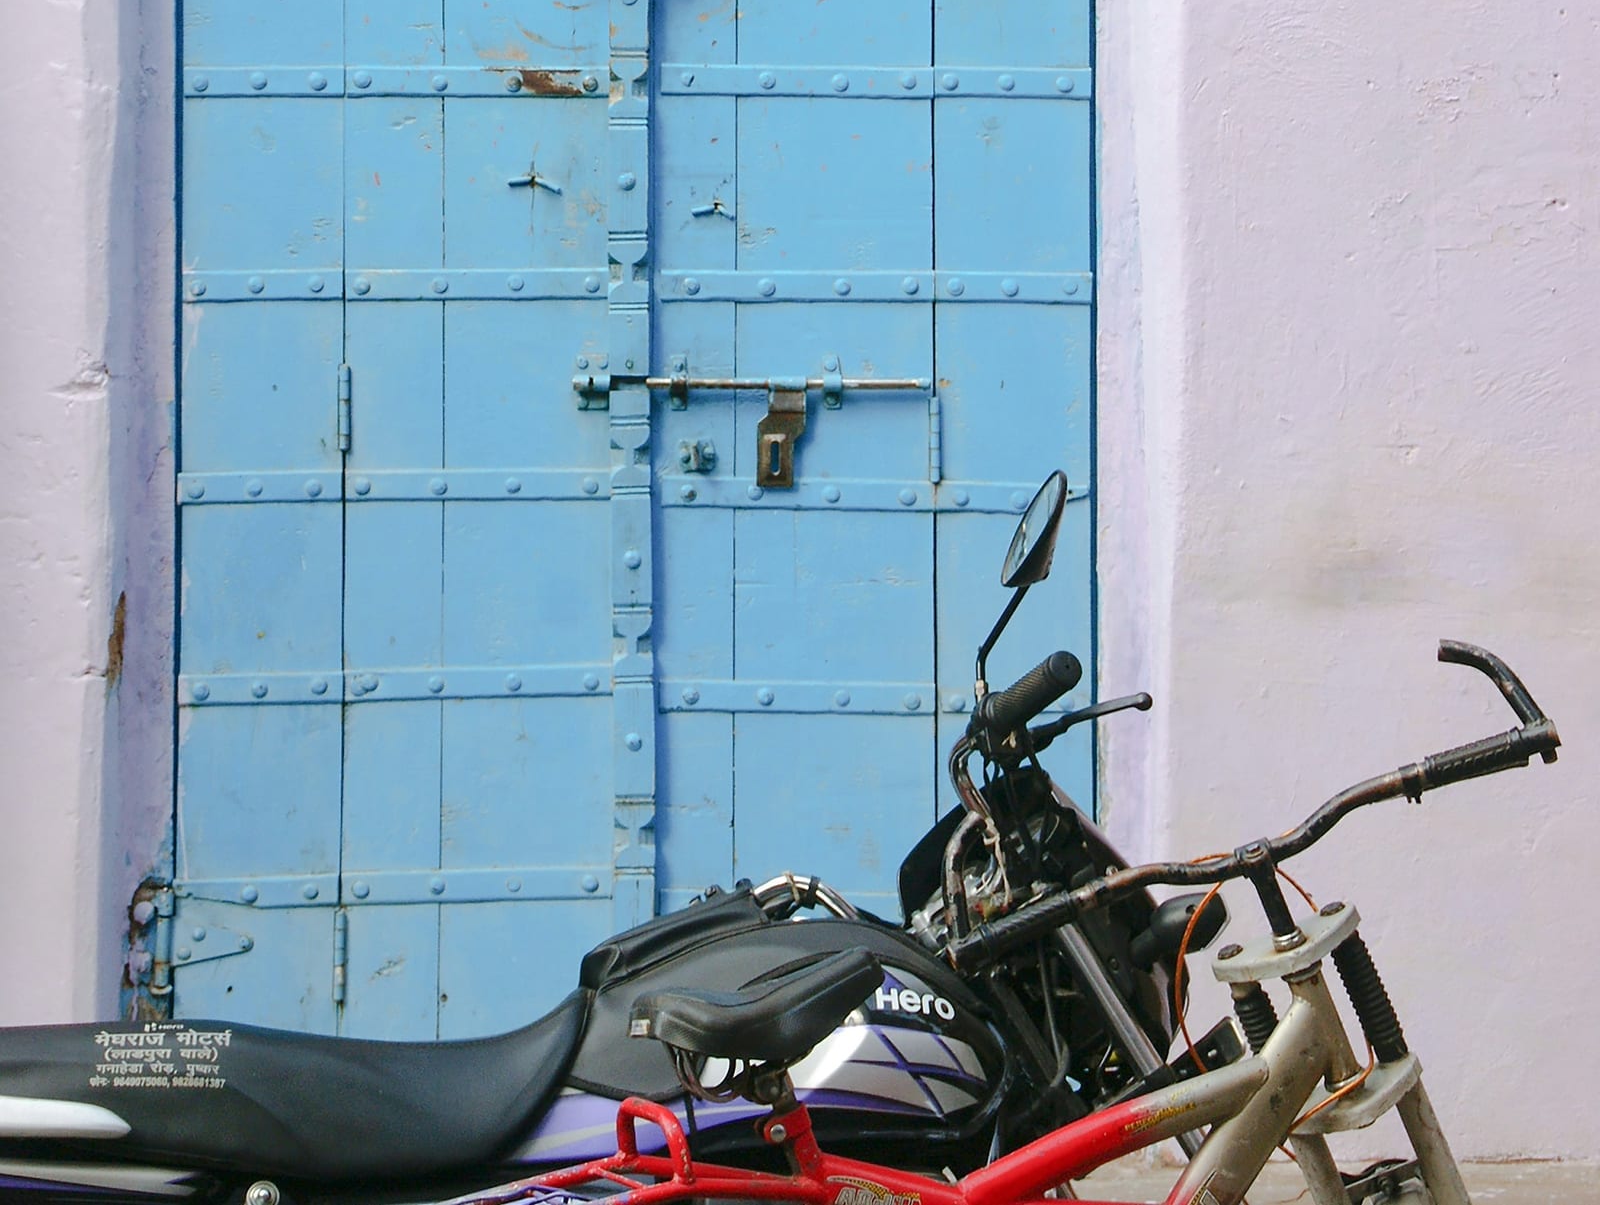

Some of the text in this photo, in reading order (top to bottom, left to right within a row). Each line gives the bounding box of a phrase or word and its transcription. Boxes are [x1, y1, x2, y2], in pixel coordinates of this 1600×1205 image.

[875, 988, 955, 1020] Hero
[94, 1029, 232, 1046] मेघराज मोटर्स
[180, 1046, 218, 1062] वाले)
